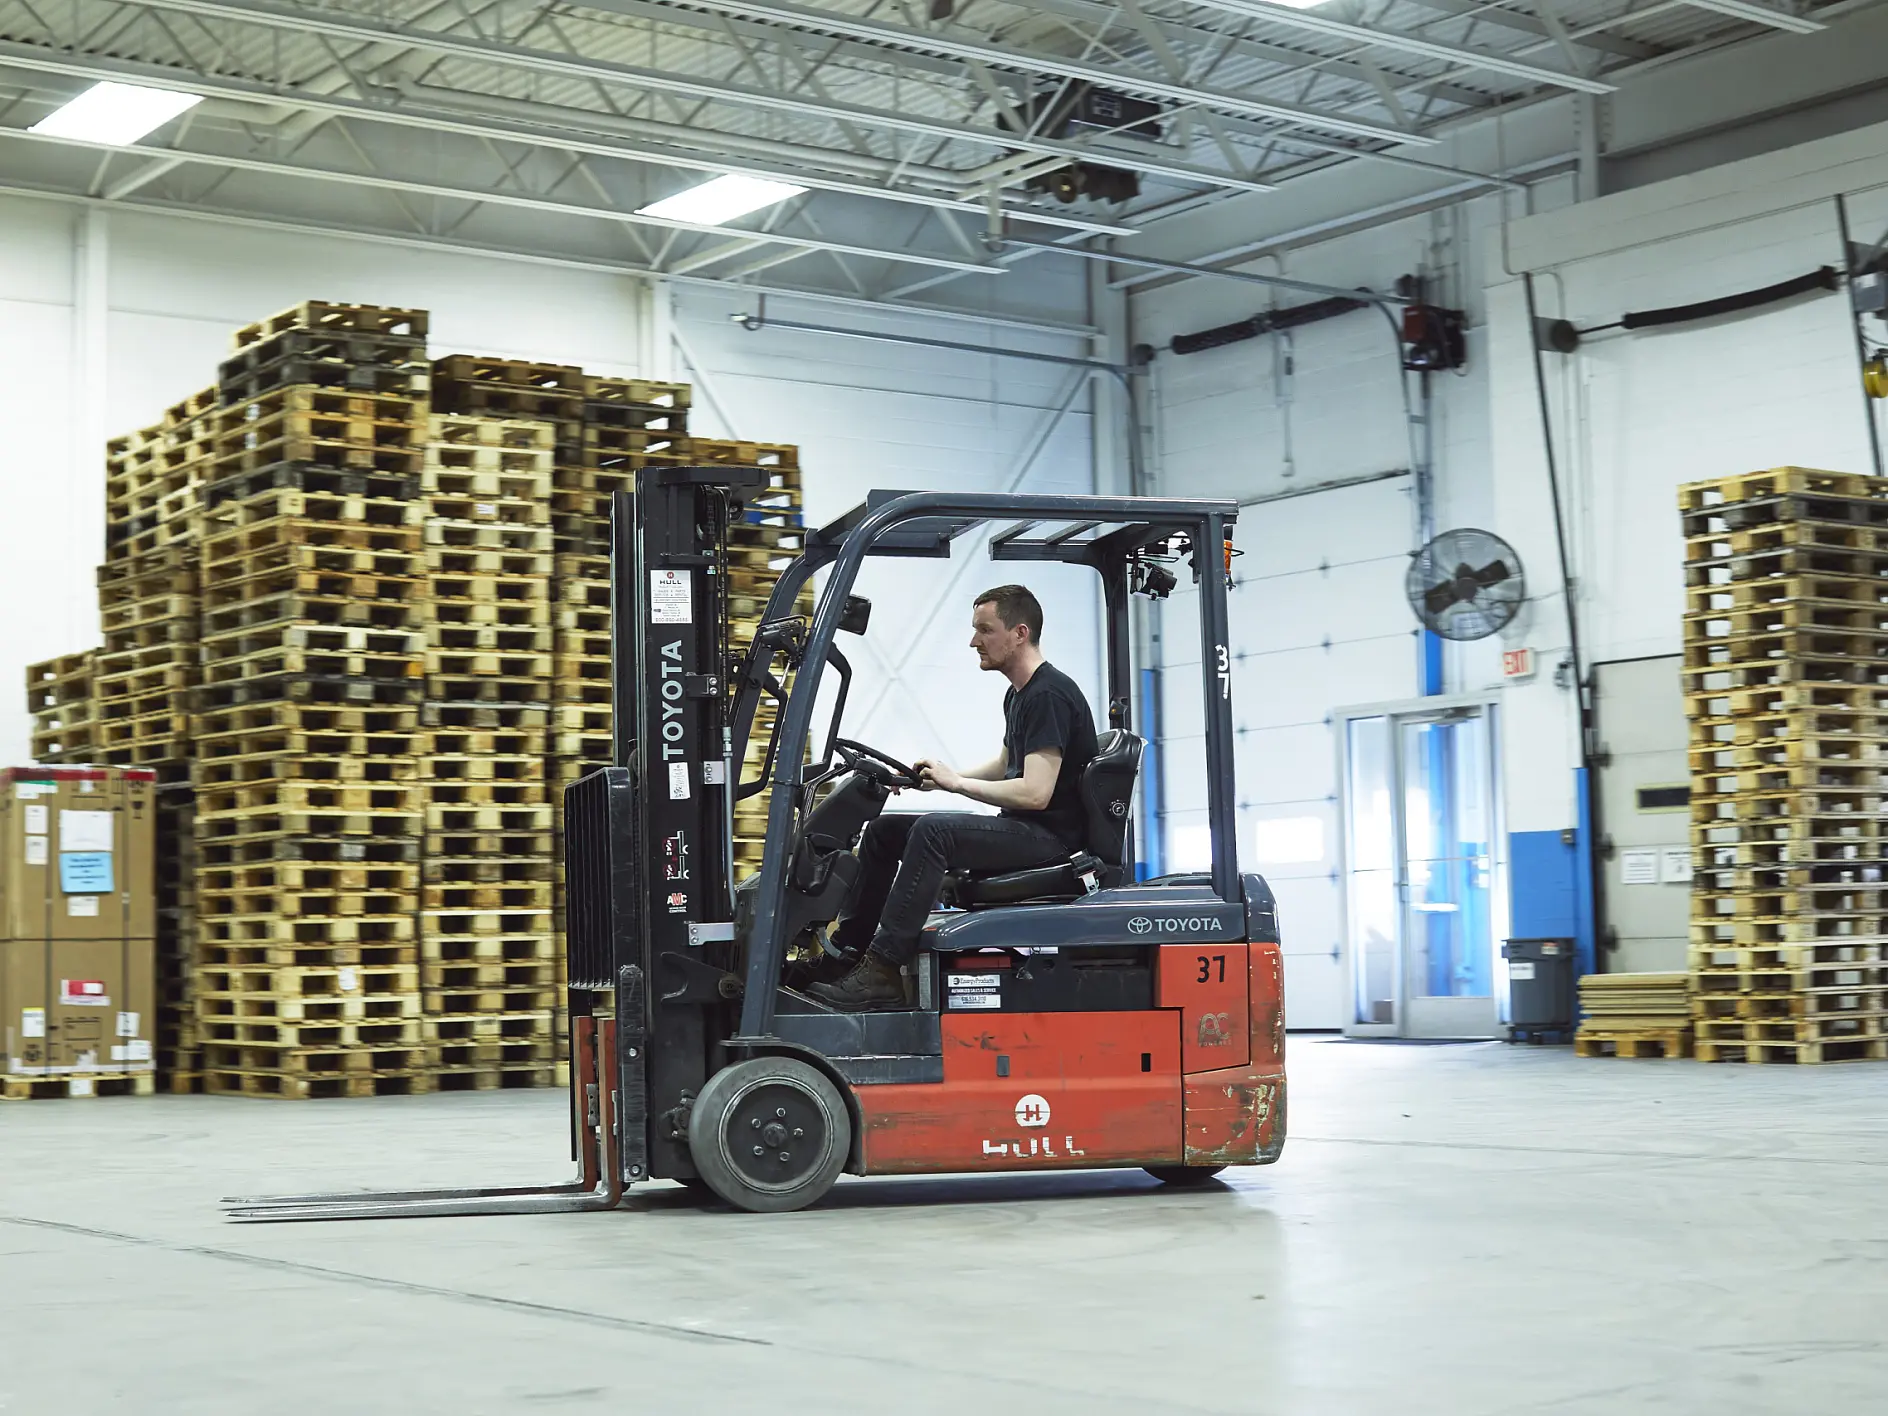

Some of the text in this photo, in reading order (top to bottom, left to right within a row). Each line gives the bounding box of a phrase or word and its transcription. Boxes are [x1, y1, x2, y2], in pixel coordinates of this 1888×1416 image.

[1504, 650, 1527, 675] EXIT
[661, 639, 684, 761] TOYOTA
[1154, 917, 1222, 931] TOYOTA
[1196, 955, 1226, 983] 37
[982, 1136, 1084, 1159] HULL
